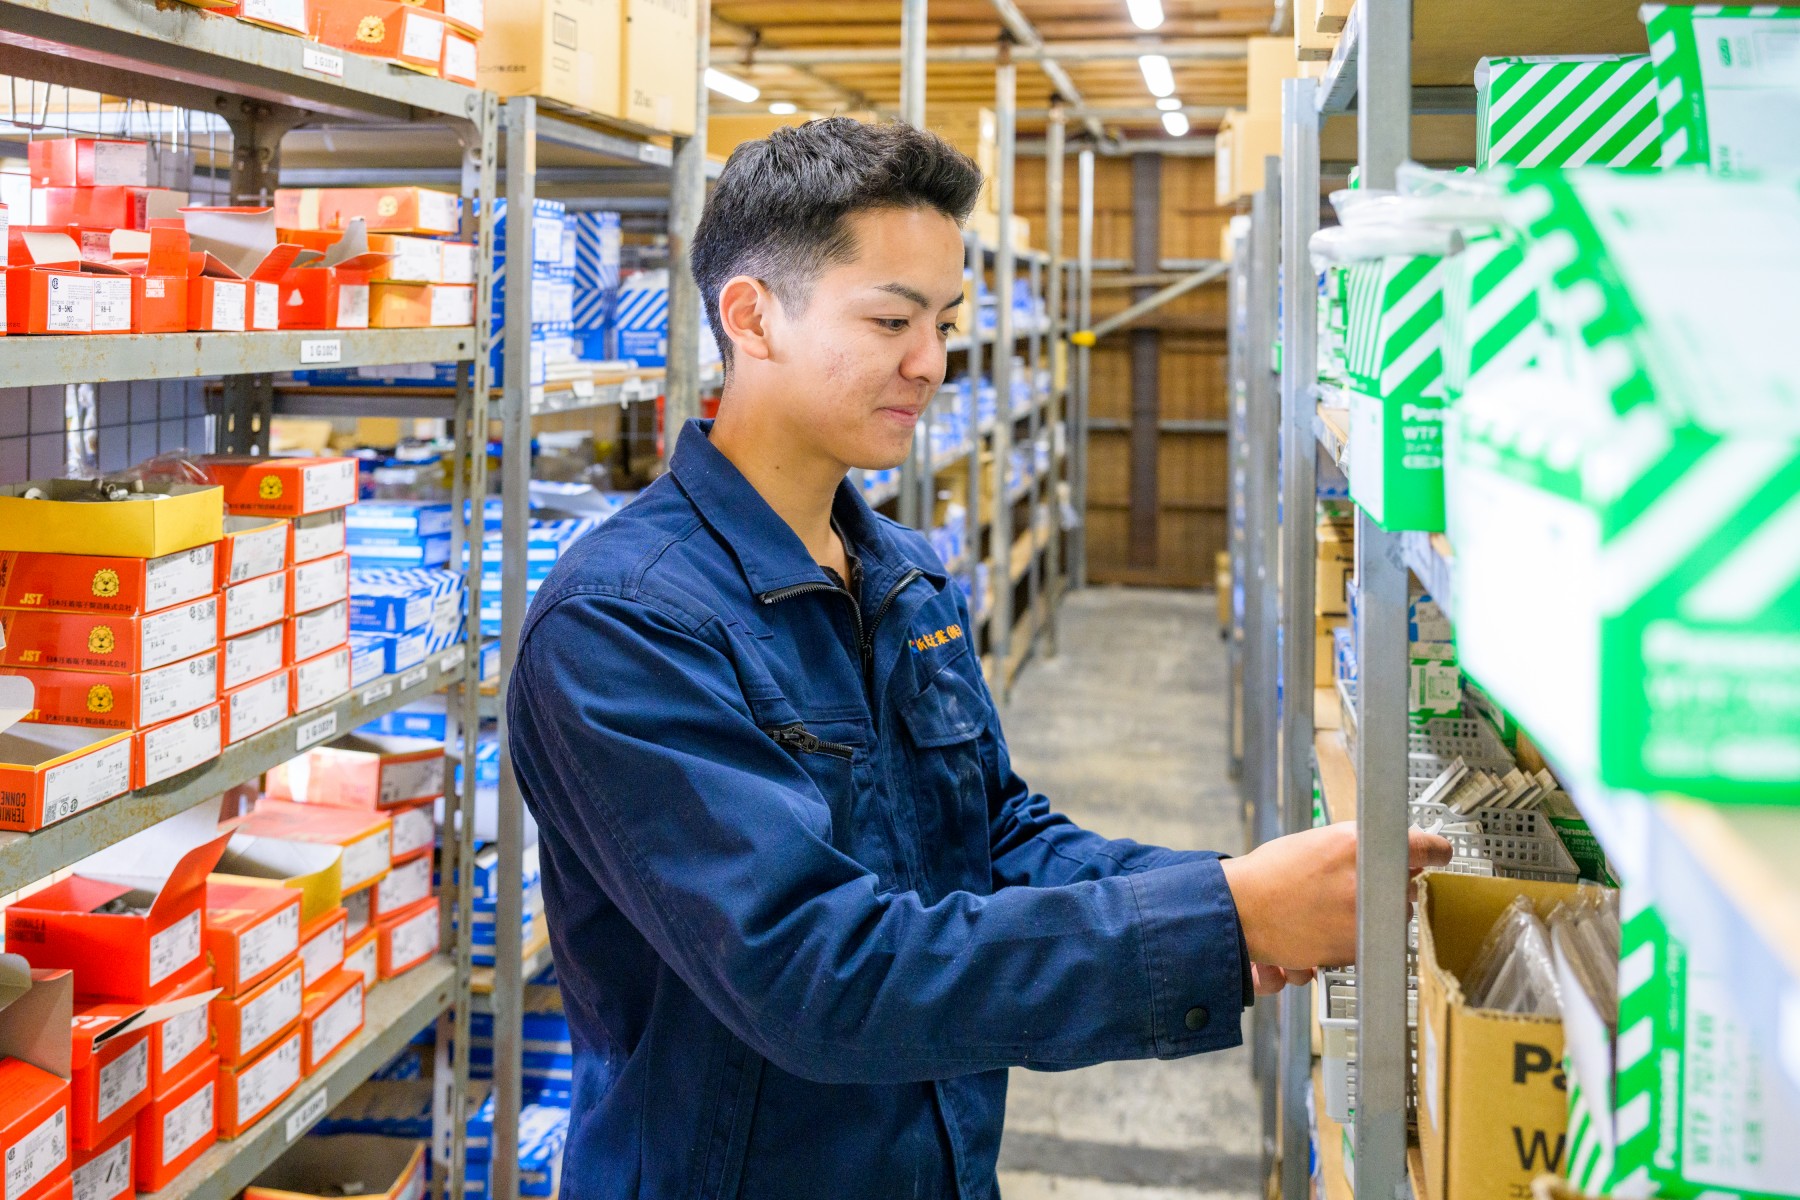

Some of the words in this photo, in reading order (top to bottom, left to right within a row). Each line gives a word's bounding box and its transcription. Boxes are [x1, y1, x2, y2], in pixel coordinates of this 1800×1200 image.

[19, 592, 44, 605] JST
[18, 649, 42, 662] JST
[0, 807, 25, 824] TERMI
